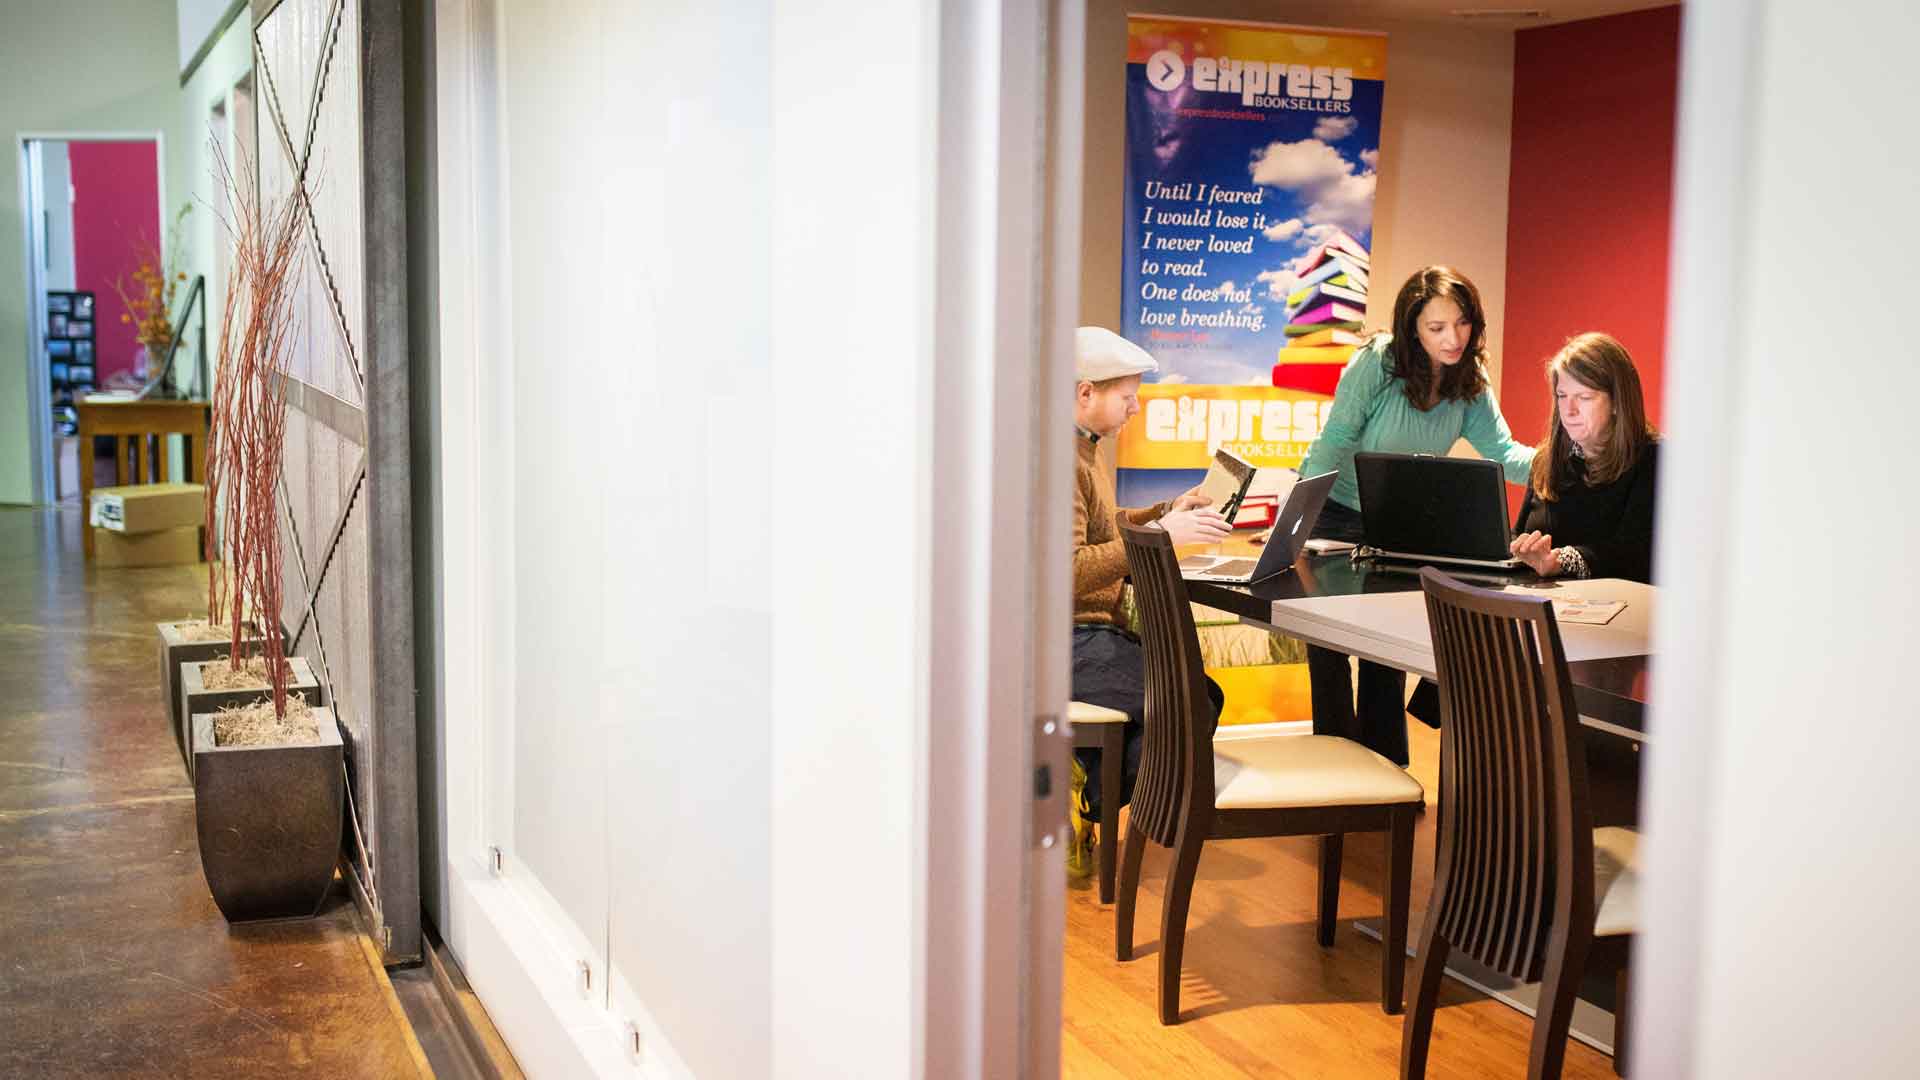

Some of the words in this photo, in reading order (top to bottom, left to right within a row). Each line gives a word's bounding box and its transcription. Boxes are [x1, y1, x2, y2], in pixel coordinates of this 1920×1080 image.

[1192, 56, 1353, 106] express
[1255, 96, 1351, 113] BOOKSELLERS
[1144, 182, 1191, 201] Until
[1196, 184, 1207, 201] I
[1208, 186, 1264, 206] feared
[1143, 207, 1154, 225] I
[1157, 209, 1211, 227] would
[1216, 211, 1248, 229] lose
[1142, 232, 1153, 249] I
[1157, 238, 1204, 252] never
[1207, 236, 1254, 254] loved
[1141, 260, 1160, 275] to
[1164, 259, 1207, 277] read.
[1141, 282, 1178, 300] One
[1181, 284, 1218, 303] does
[1140, 307, 1176, 326] love
[1180, 309, 1266, 332] breathing.
